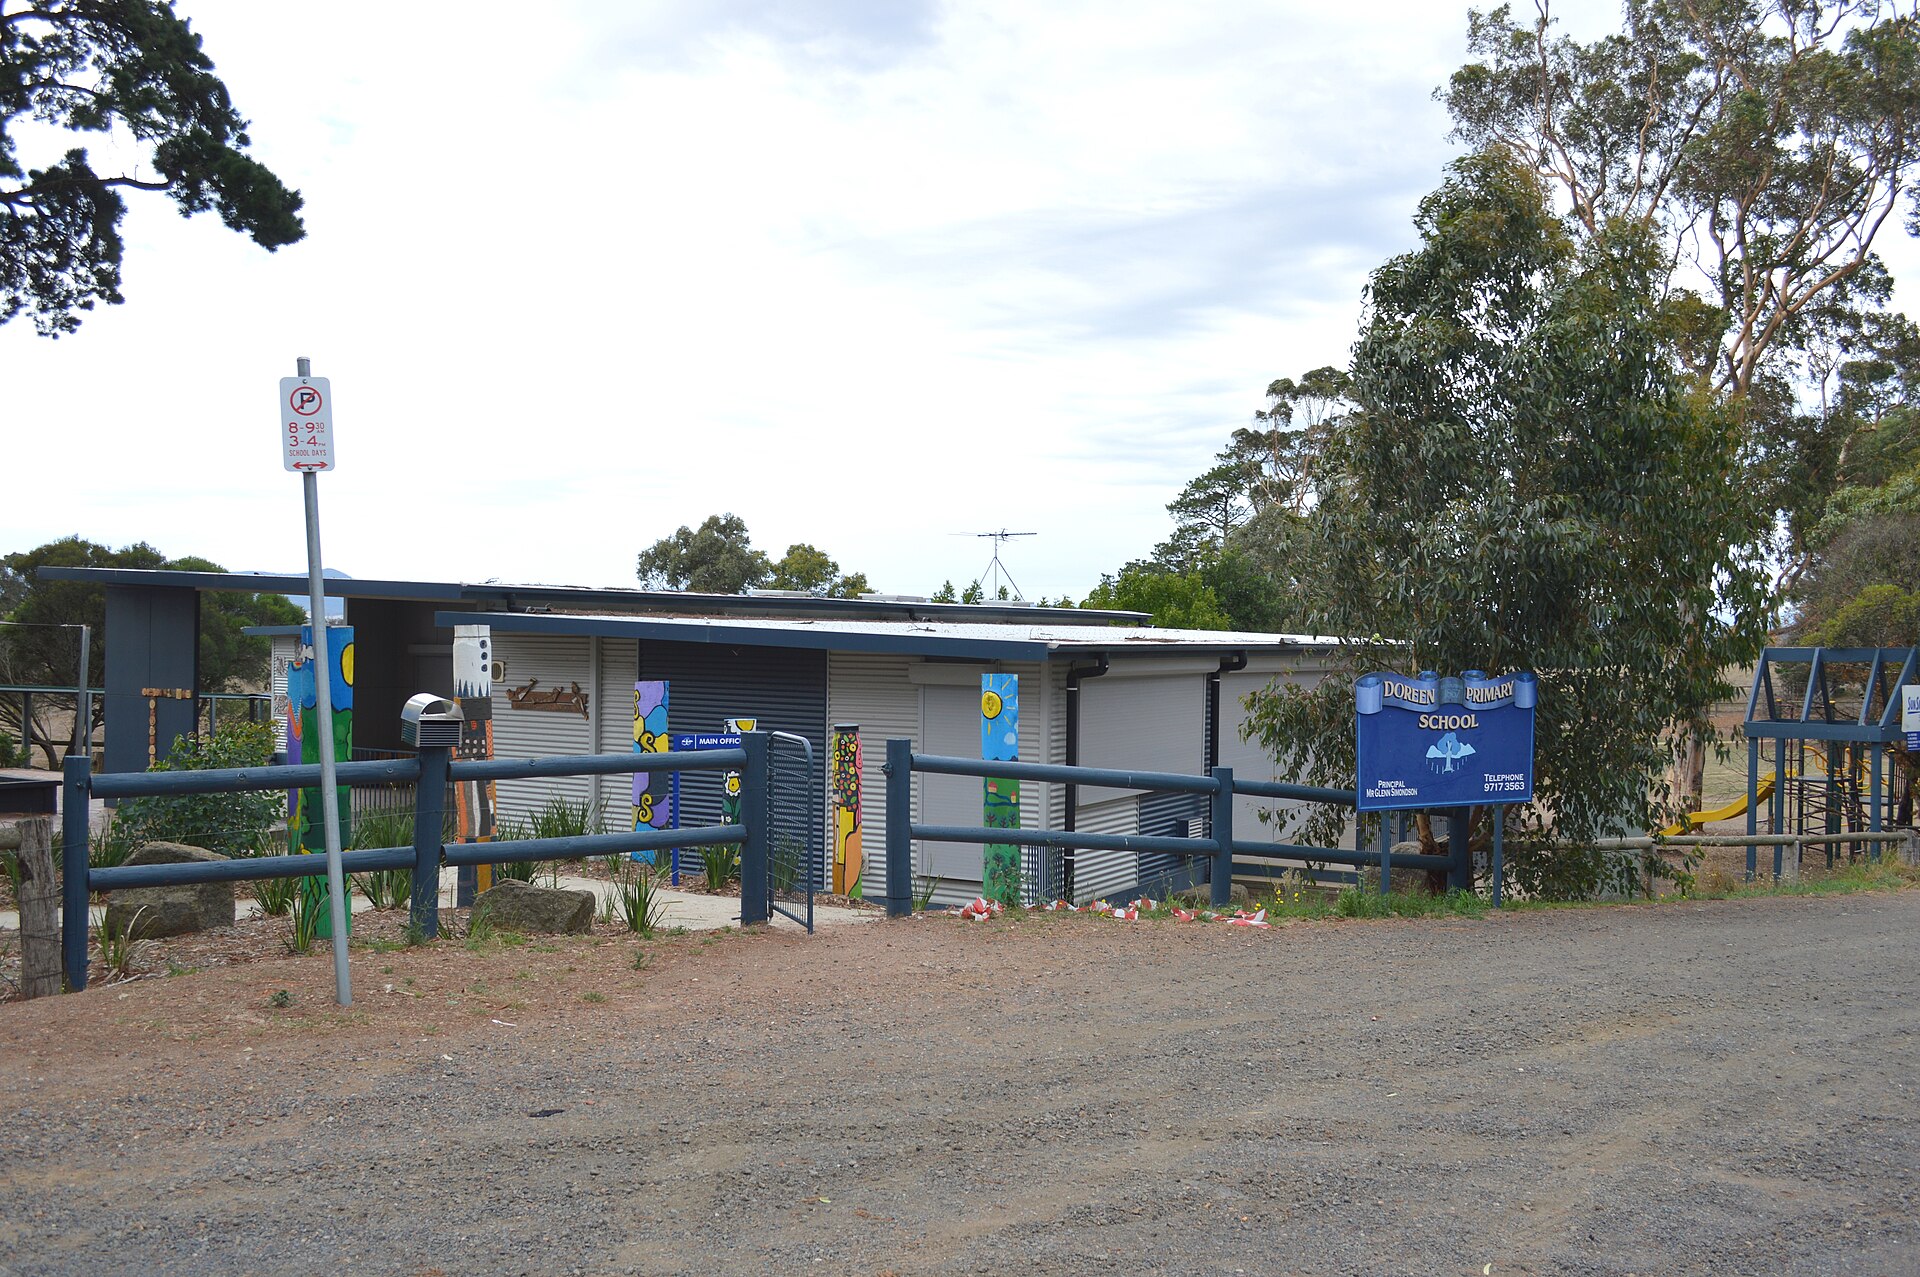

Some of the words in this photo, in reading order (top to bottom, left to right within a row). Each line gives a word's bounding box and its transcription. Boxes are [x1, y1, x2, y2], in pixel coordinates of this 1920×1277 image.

[1384, 681, 1436, 704] DOREEN
[1466, 680, 1514, 703] PRIMARY
[1418, 714, 1479, 730] SCHOOL
[1484, 773, 1524, 782] TELEPHONE
[1378, 780, 1405, 788] PRINCIPAL
[1484, 782, 1504, 792] 9717
[1504, 782, 1525, 791] 3563
[1366, 788, 1375, 798] MR
[1375, 788, 1391, 797] GLENN
